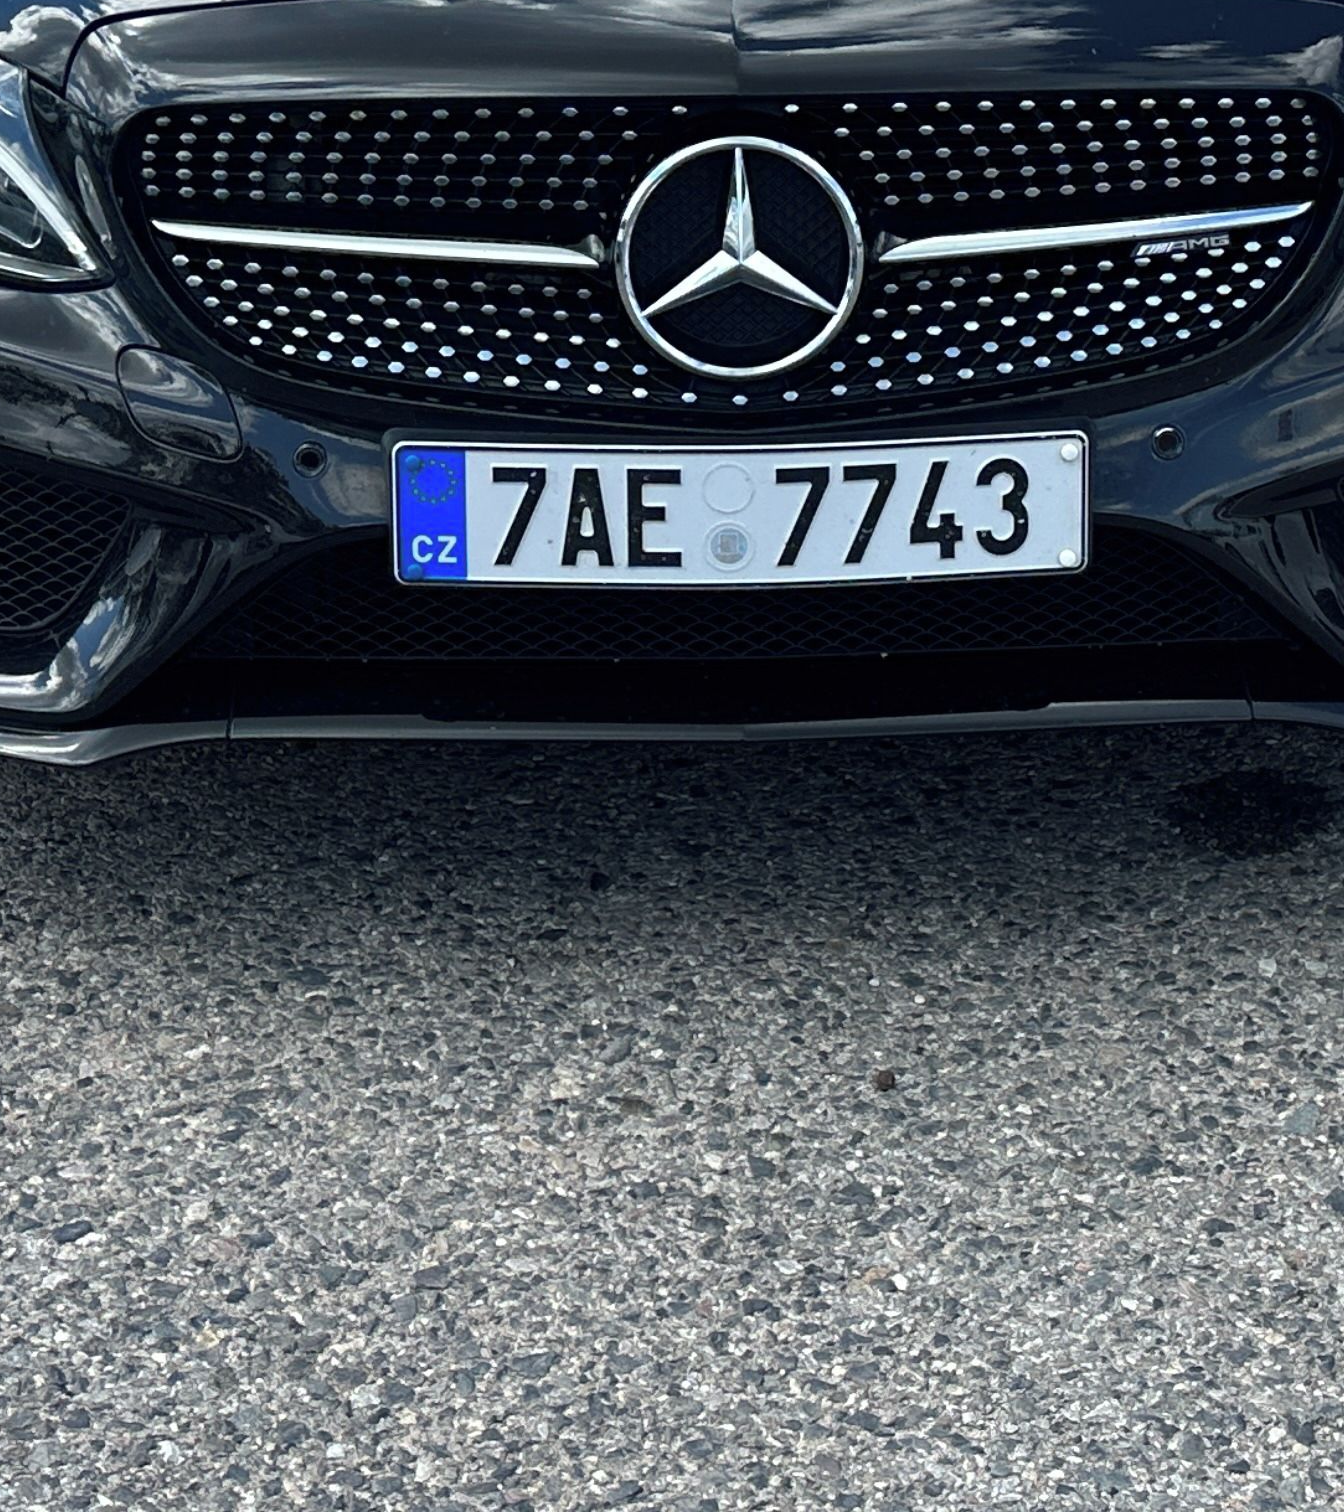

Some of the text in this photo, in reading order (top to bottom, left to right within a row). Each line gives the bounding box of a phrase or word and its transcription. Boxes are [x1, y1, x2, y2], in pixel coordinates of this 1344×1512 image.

[492, 457, 1029, 568] 7AE 7743
[412, 535, 457, 564] CZ
